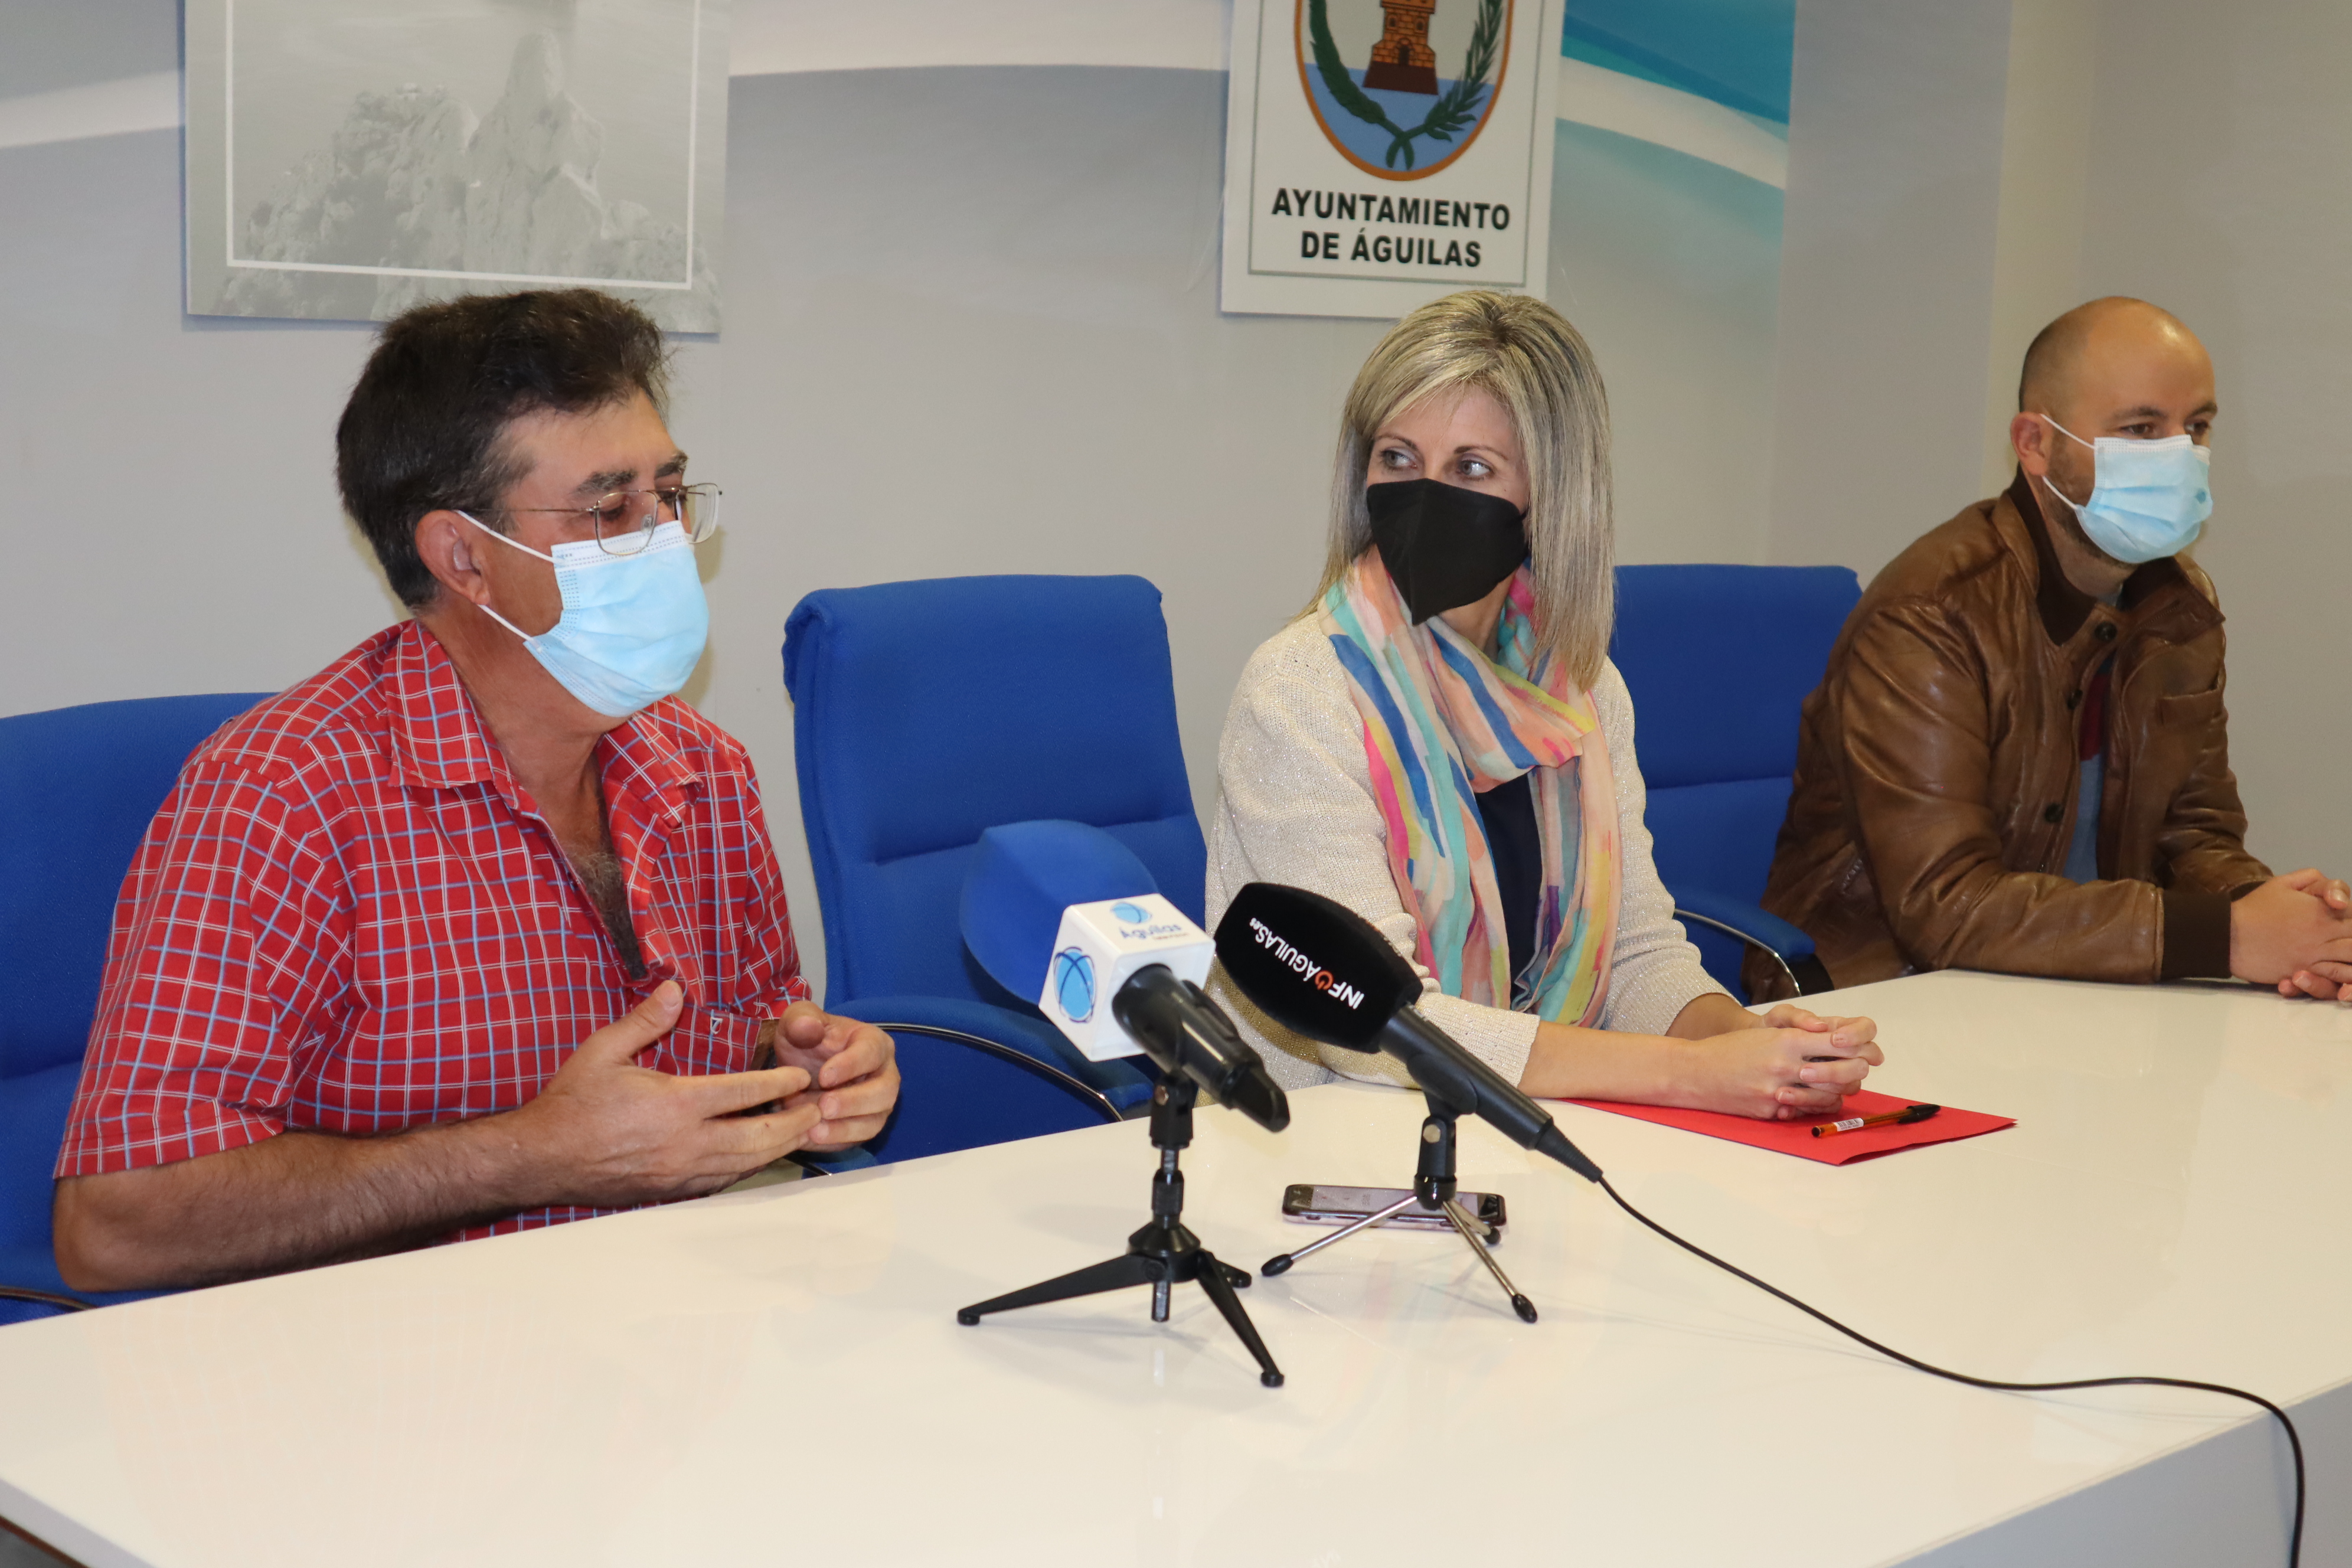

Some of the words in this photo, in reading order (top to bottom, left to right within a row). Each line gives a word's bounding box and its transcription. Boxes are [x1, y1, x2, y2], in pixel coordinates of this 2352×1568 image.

[1272, 188, 1510, 230] AYUNTAMIENTO
[1301, 231, 1340, 260] DE
[1350, 227, 1482, 267] ÁGUILAS
